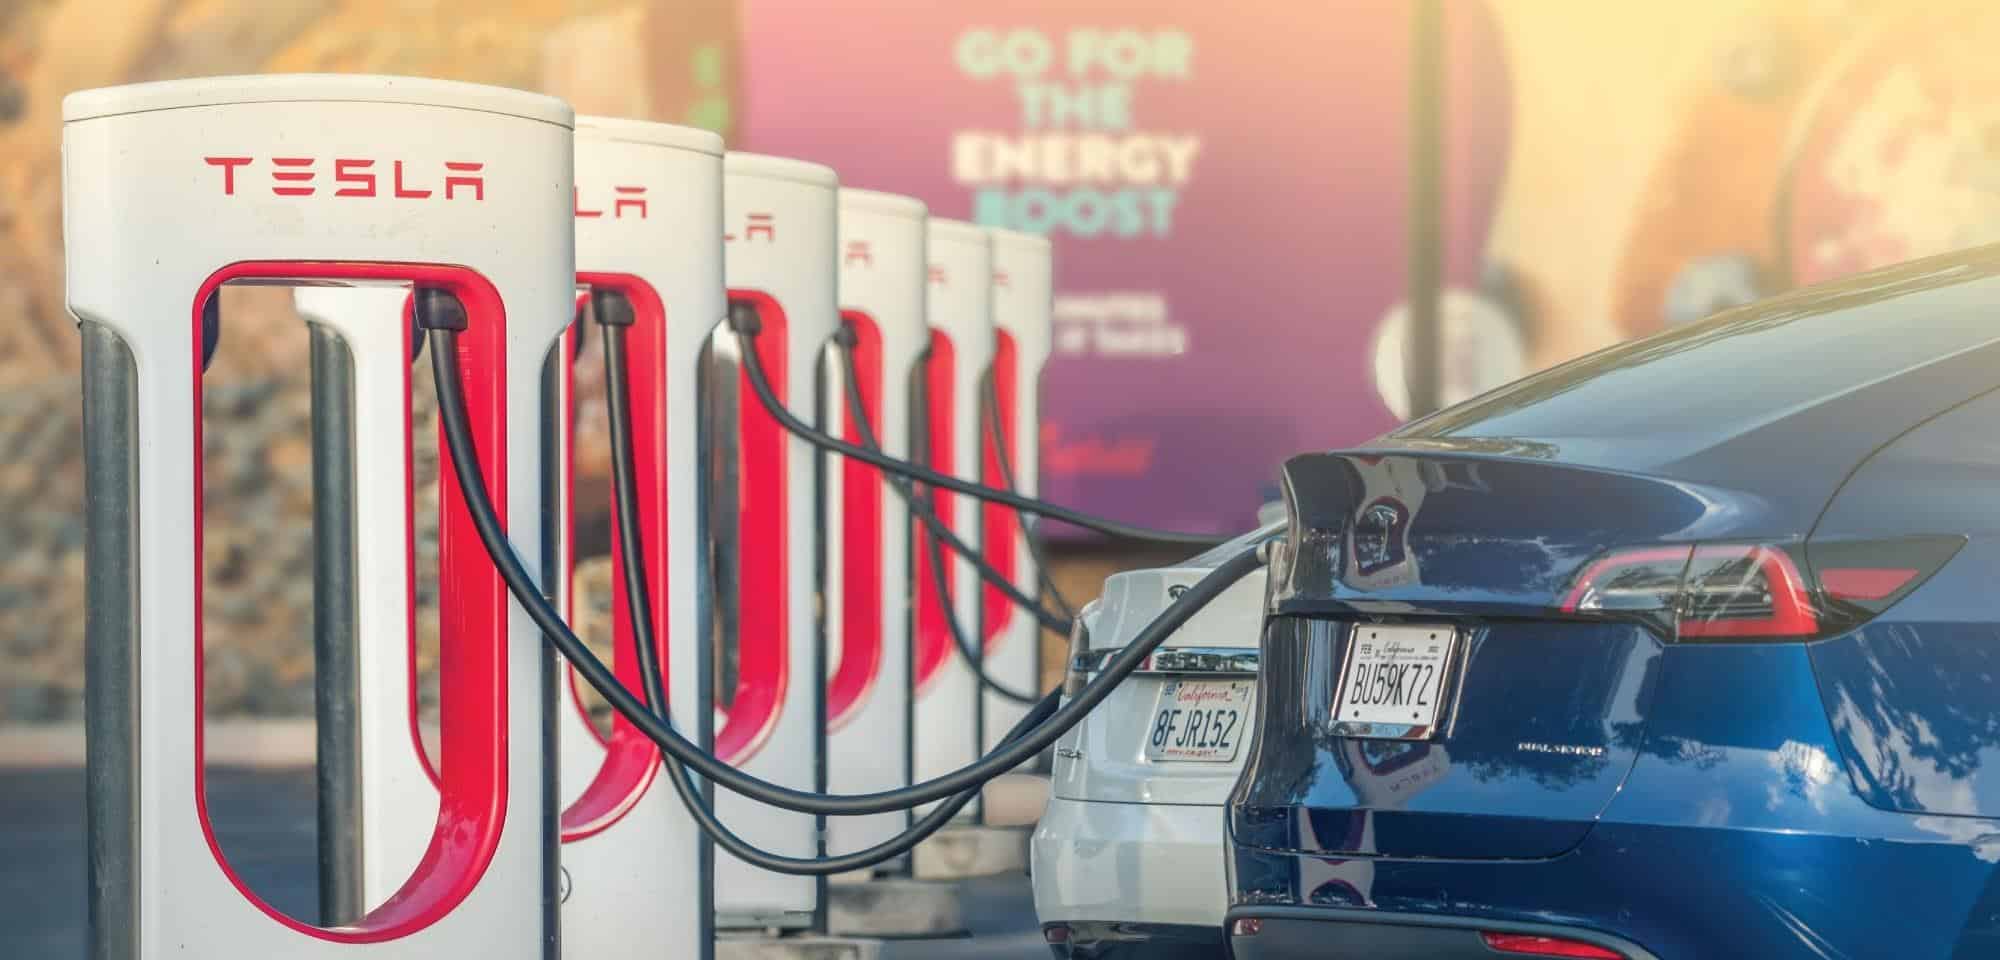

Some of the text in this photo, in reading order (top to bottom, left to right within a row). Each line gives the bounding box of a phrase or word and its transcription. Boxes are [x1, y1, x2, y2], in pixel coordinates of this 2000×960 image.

[955, 30, 1193, 80] GO FOR
[1016, 83, 1132, 128] THE
[203, 157, 484, 201] TESLA
[954, 133, 1202, 186] ENERGY
[974, 188, 1176, 239] BOOST
[1178, 682, 1232, 705] California
[1350, 663, 1433, 706] BU59K72
[1152, 709, 1237, 748] 8FJR152
